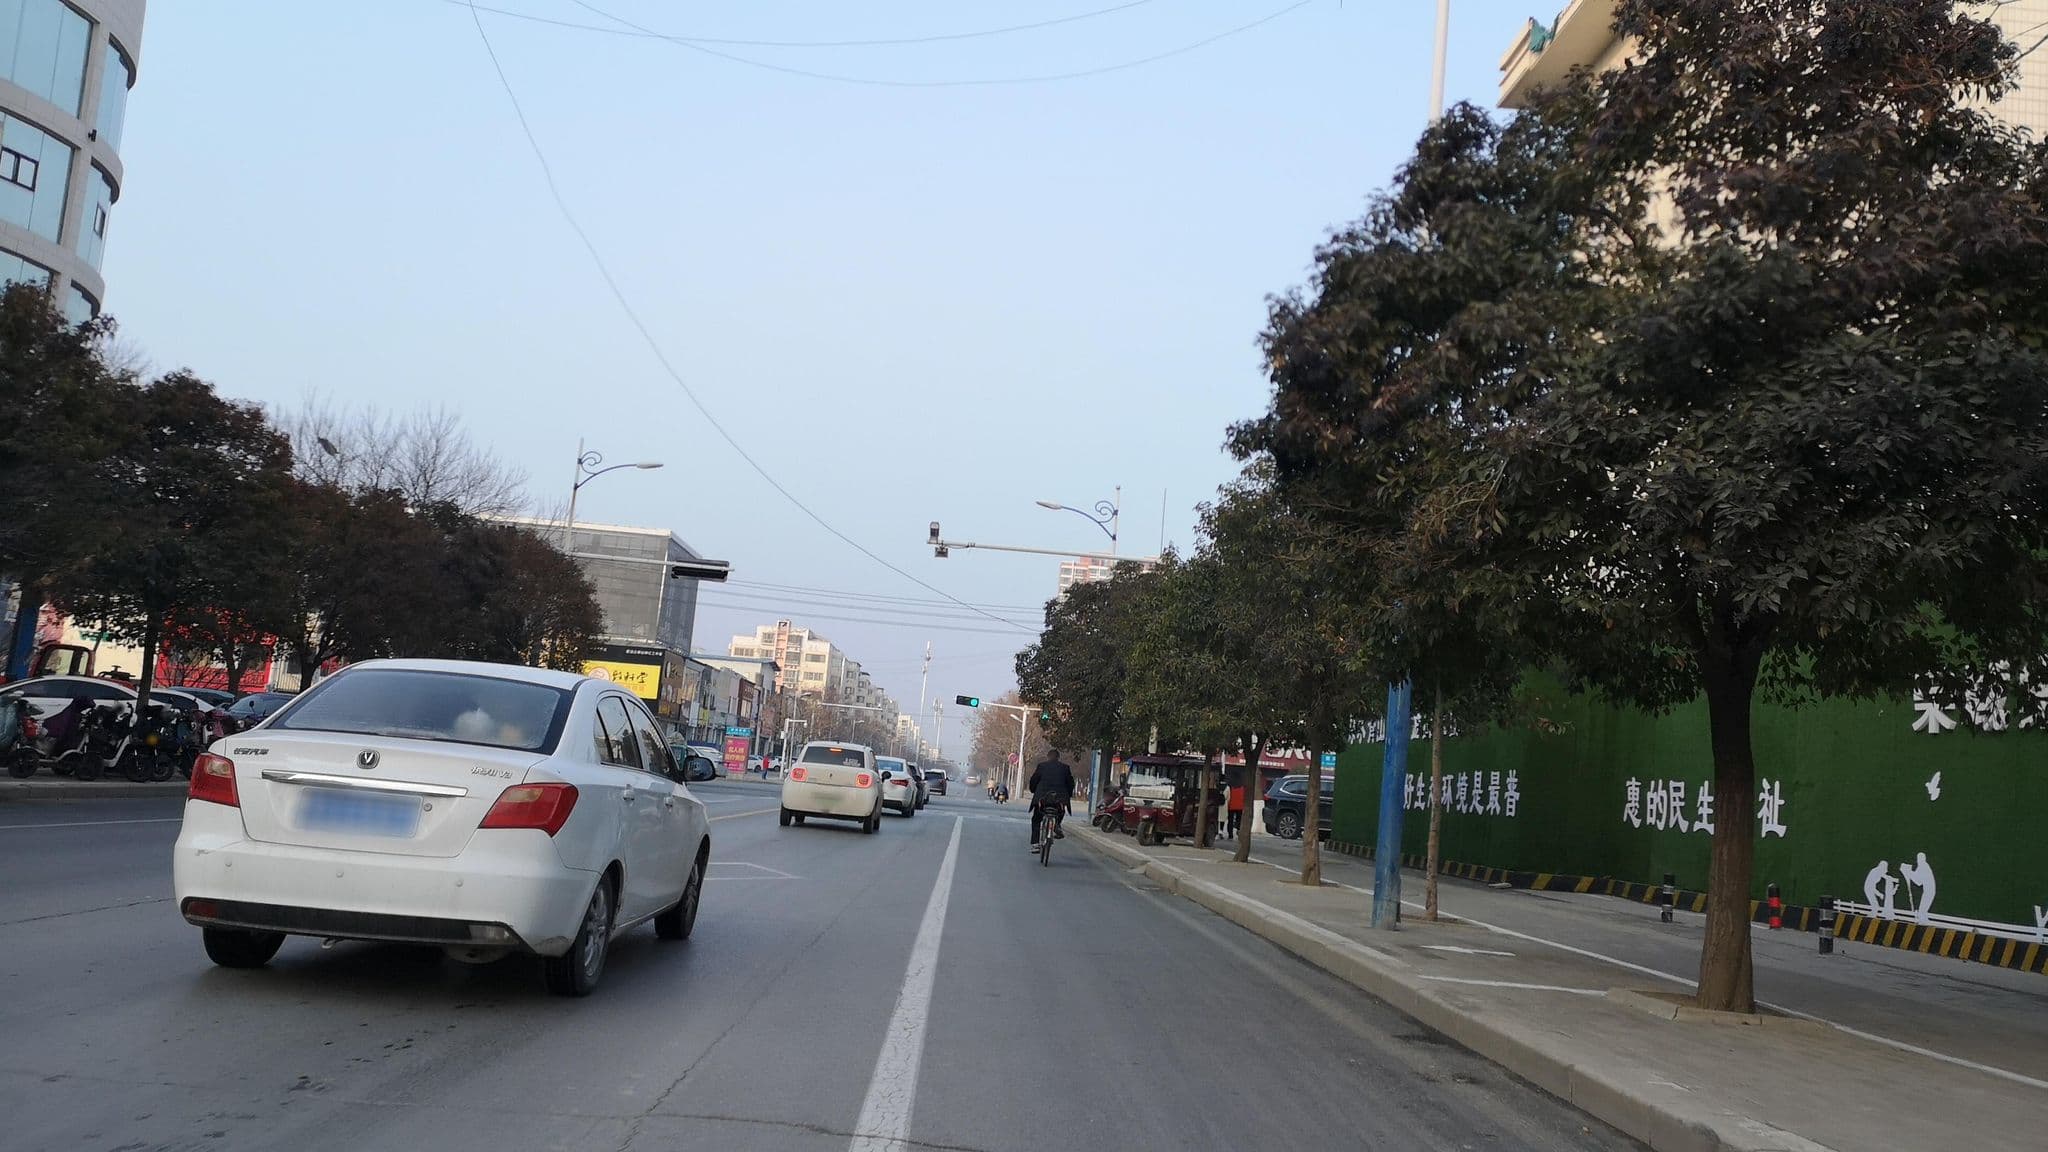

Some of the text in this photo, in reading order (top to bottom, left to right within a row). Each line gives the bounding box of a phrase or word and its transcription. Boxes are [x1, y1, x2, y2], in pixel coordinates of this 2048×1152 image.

[1623, 776, 1787, 838] 惠的民生祉
